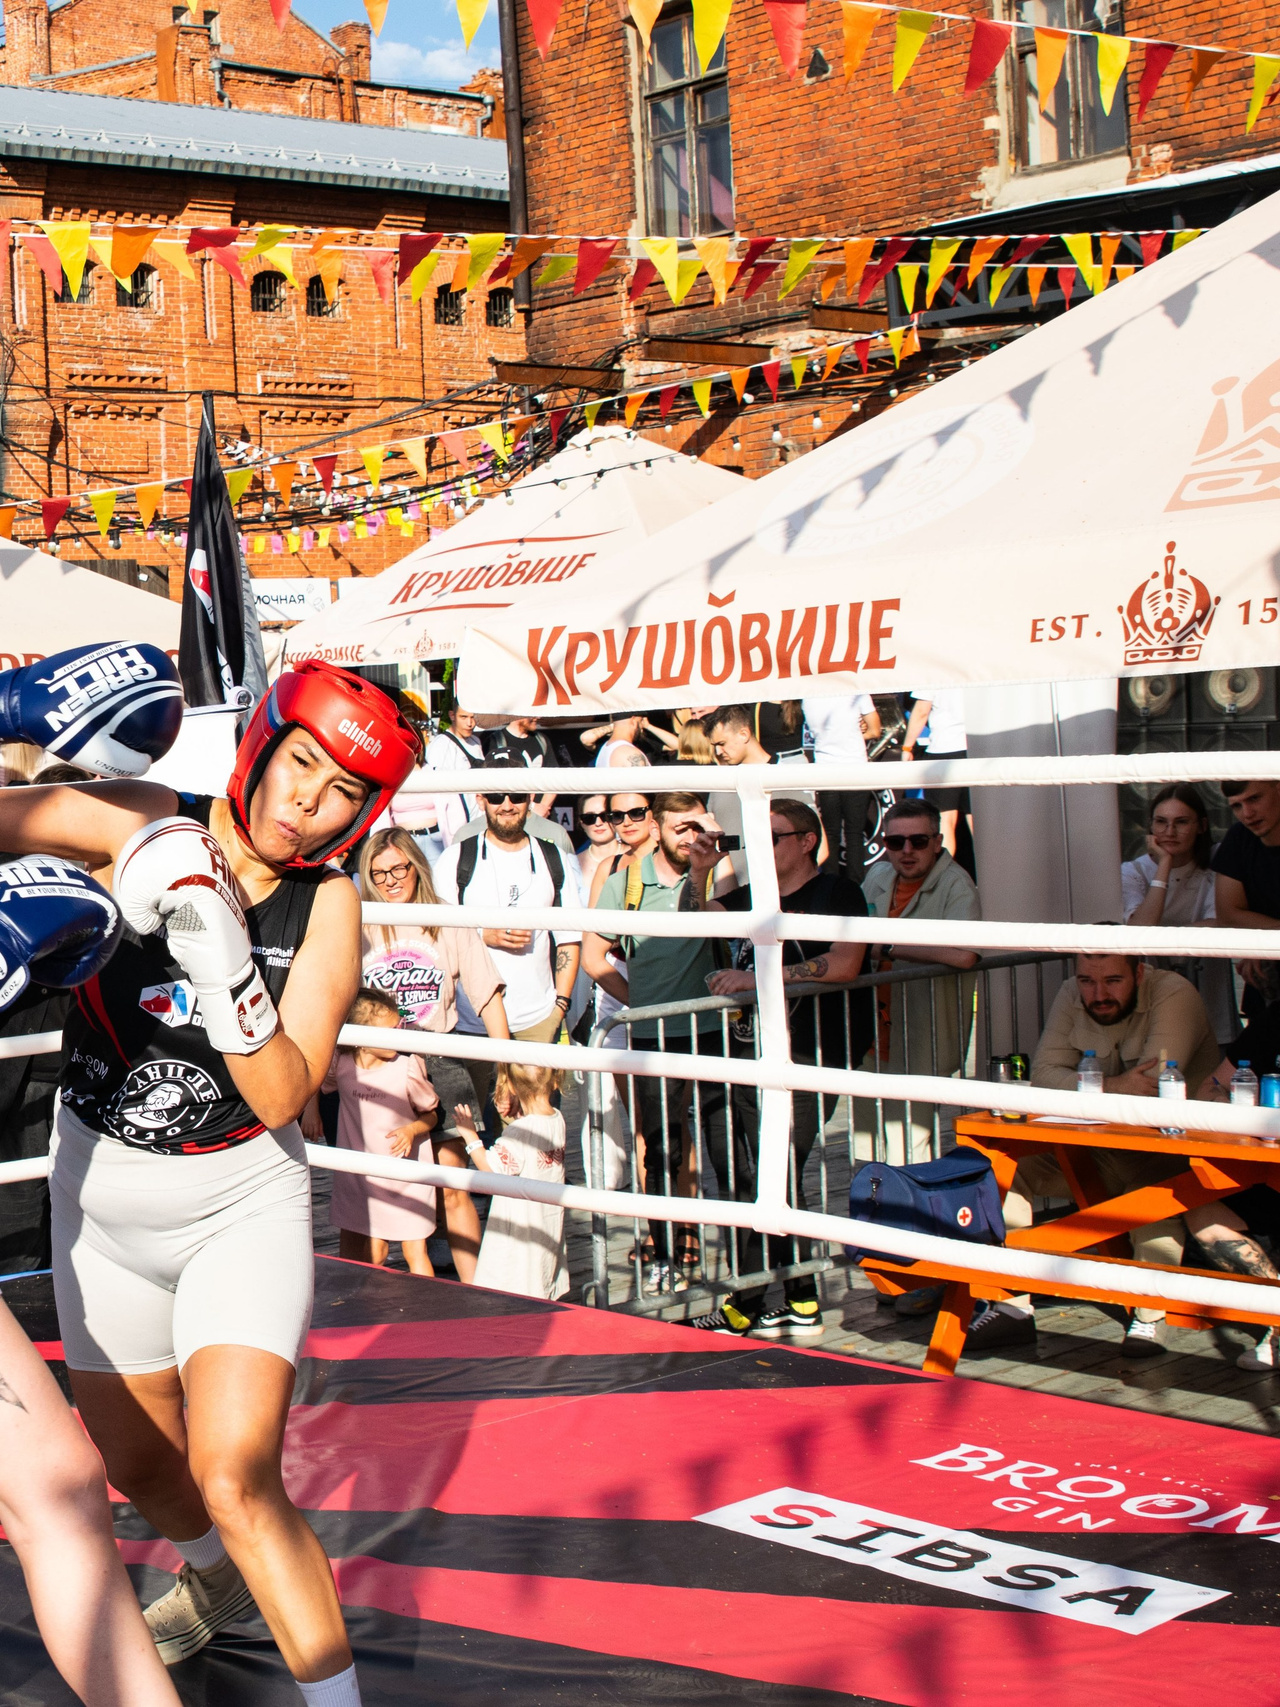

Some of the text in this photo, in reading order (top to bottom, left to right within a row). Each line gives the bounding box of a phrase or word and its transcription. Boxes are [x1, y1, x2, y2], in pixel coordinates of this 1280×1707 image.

[1030, 597, 1278, 643] EST. 15
[44, 663, 158, 732] GREEN
[337, 717, 383, 759] clinch
[363, 963, 445, 993] Repair
[394, 961, 413, 970] AUTO
[404, 990, 437, 1005] SERVICE
[992, 1496, 1116, 1530] GIN
[749, 1503, 1157, 1617] SIBSA
